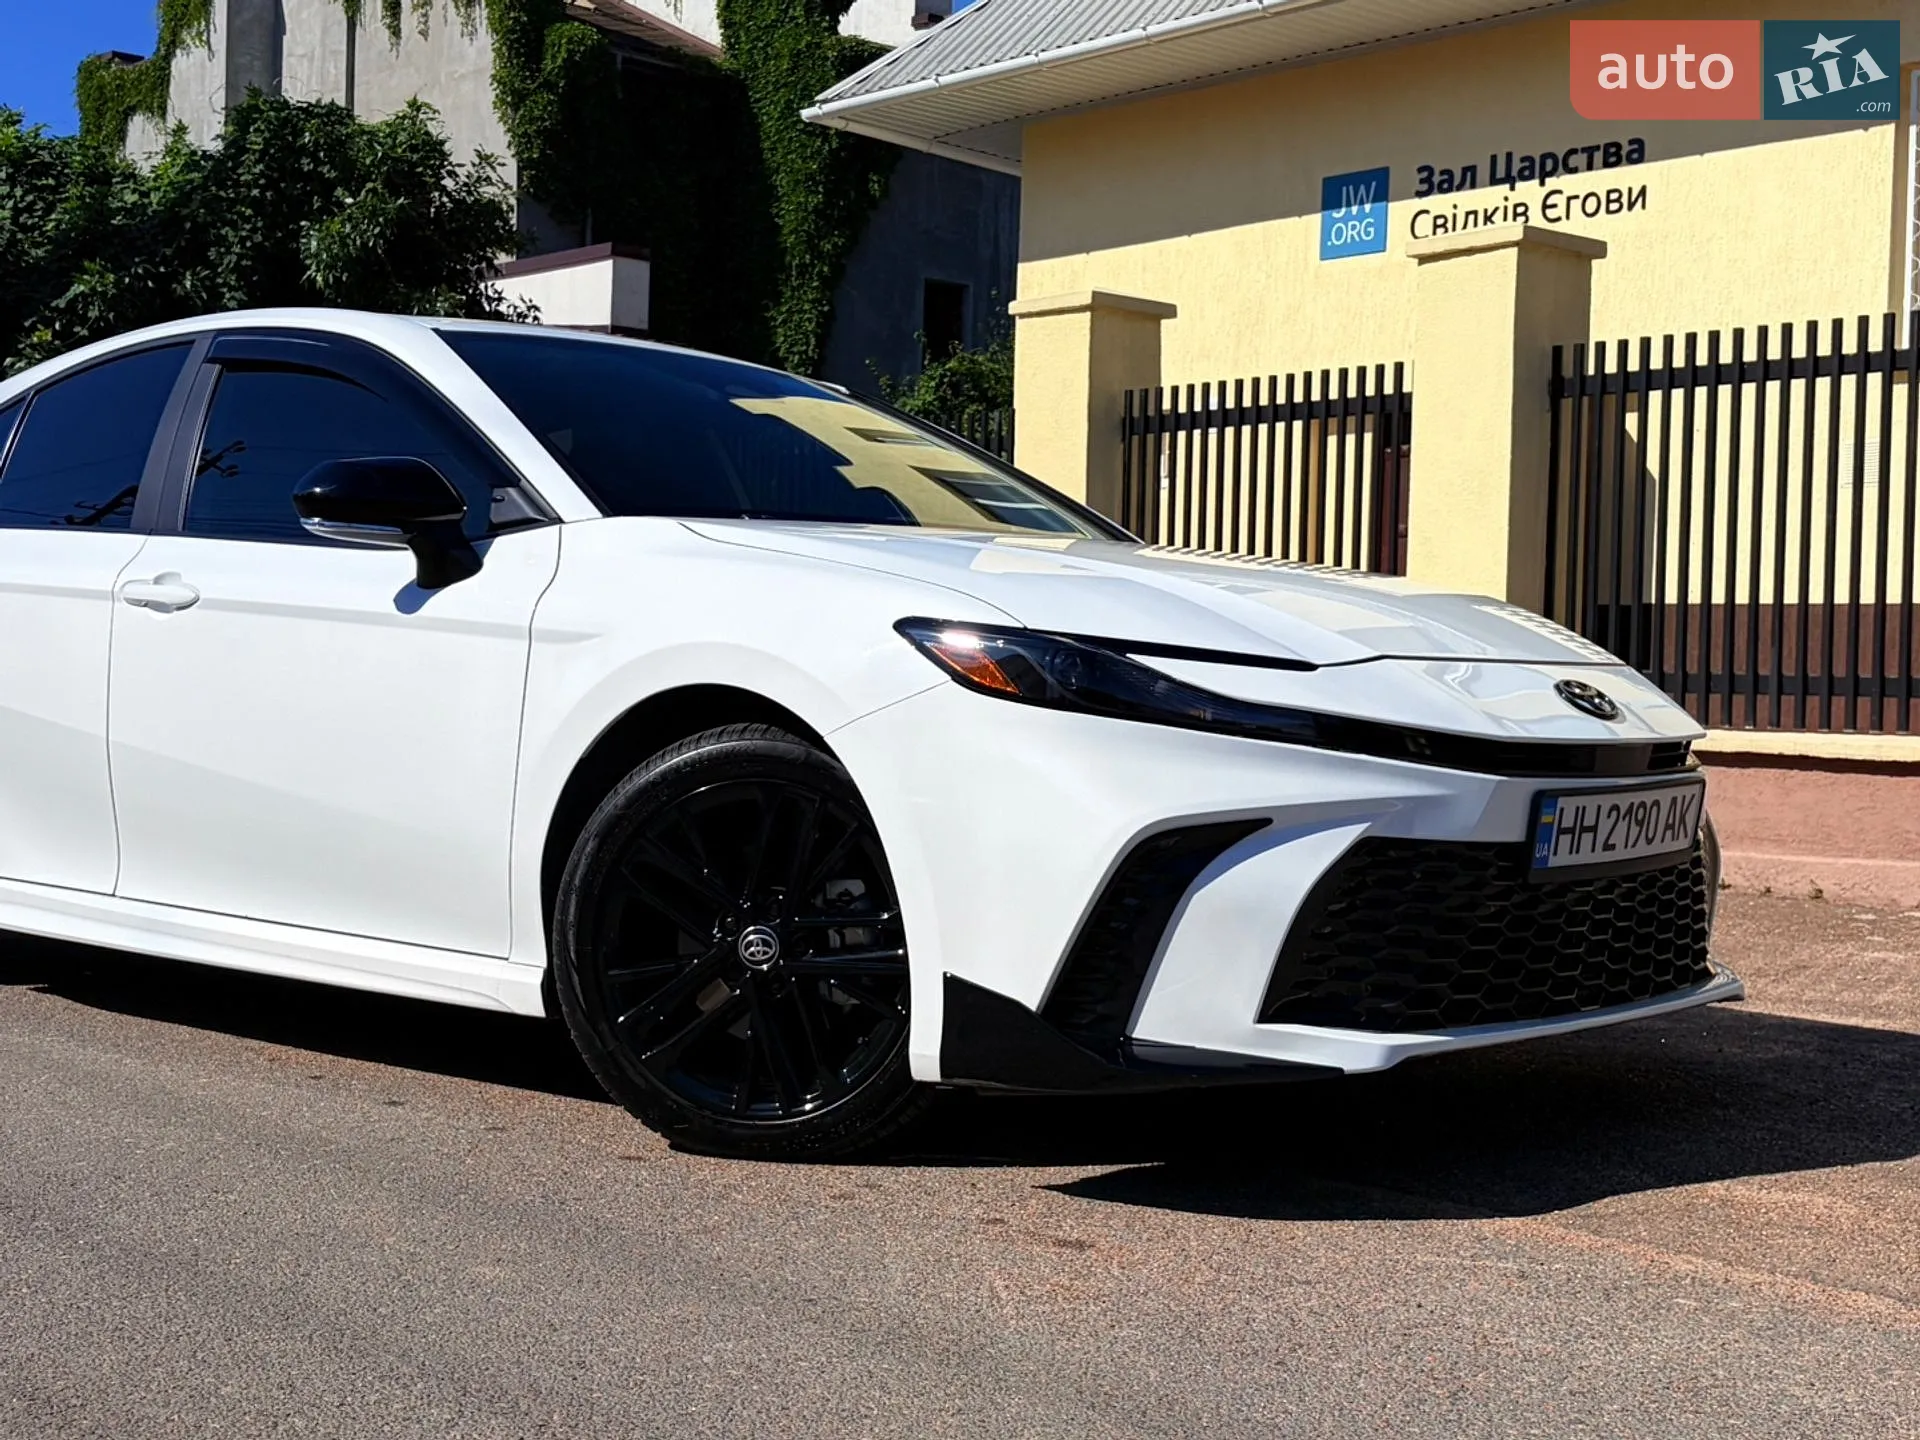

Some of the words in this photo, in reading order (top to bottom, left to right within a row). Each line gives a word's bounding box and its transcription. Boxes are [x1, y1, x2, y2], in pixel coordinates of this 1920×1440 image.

[1414, 164, 1478, 198] Зал
[1490, 137, 1646, 190] Царства
[1332, 181, 1376, 218] JW
[1541, 184, 1648, 224] Єгови
[1327, 218, 1375, 247] .ORG
[1553, 804, 1602, 857] HH
[1602, 798, 1661, 852] 2190
[1660, 794, 1697, 844] AK
[1535, 843, 1549, 858] UA
